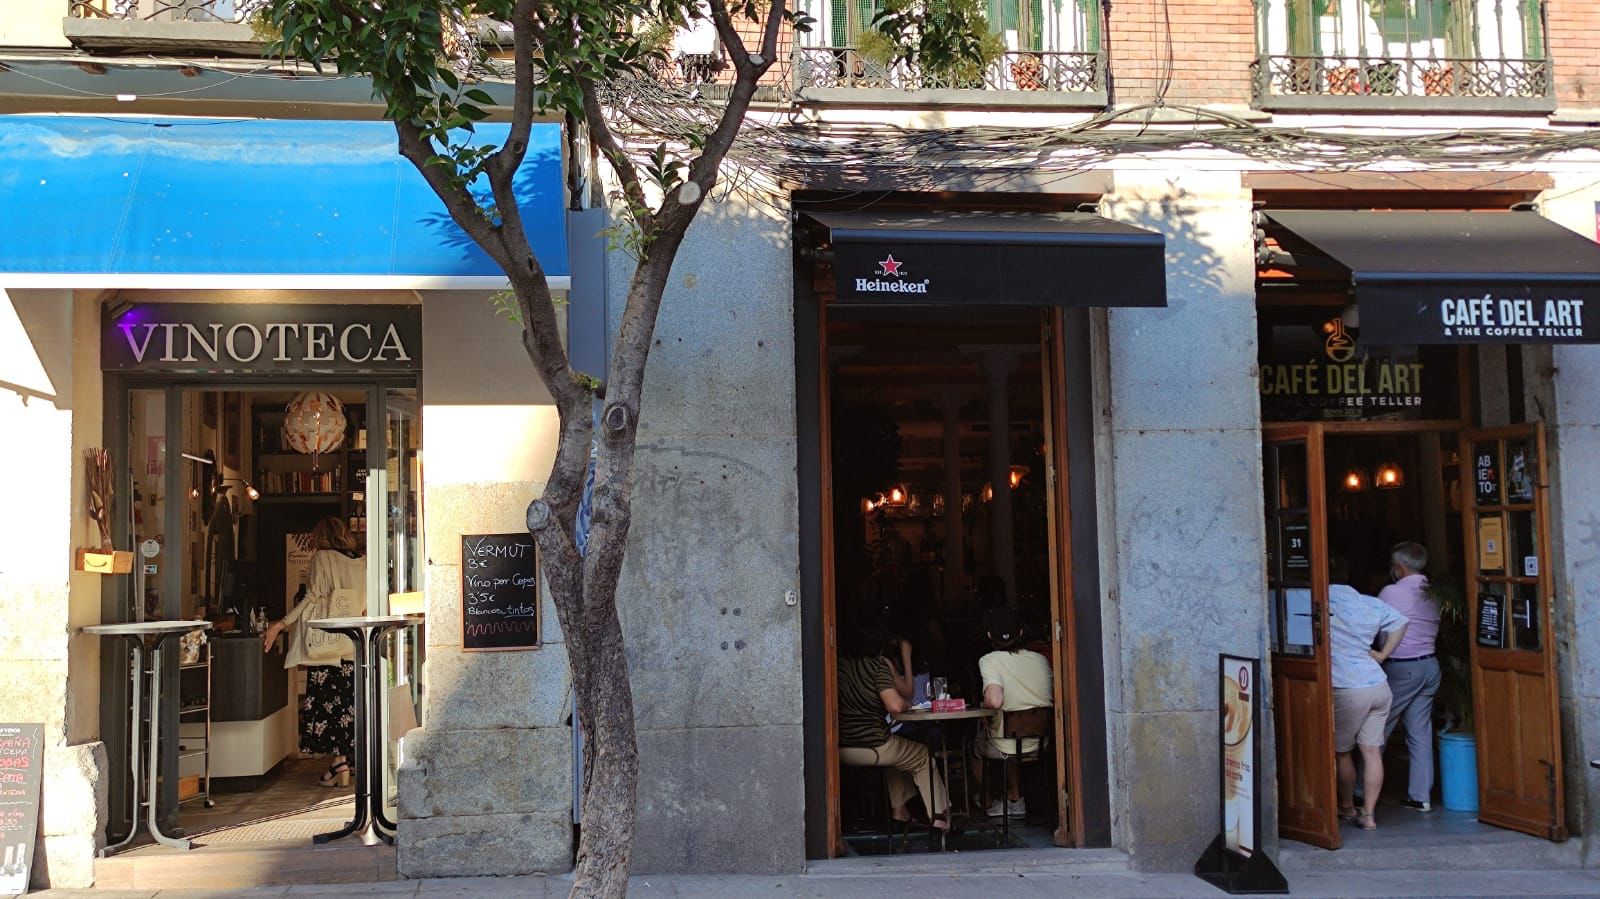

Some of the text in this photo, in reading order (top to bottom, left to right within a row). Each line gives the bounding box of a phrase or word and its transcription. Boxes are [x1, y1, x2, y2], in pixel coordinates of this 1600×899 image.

[1441, 294, 1585, 327] CAFÉ DEL ART
[1444, 327, 1583, 337] & THE COFFEE TELLER
[118, 322, 412, 363] VINOTECA
[1260, 359, 1424, 396] CAFÉ DEL ART
[1372, 397, 1423, 406] TELLER
[1478, 455, 1491, 467] AB
[1478, 481, 1492, 493] TO
[466, 537, 531, 558] VERMUT
[1291, 538, 1302, 548] 31
[466, 574, 491, 588] Vino
[493, 578, 510, 589] por
[506, 601, 535, 618] tintos
